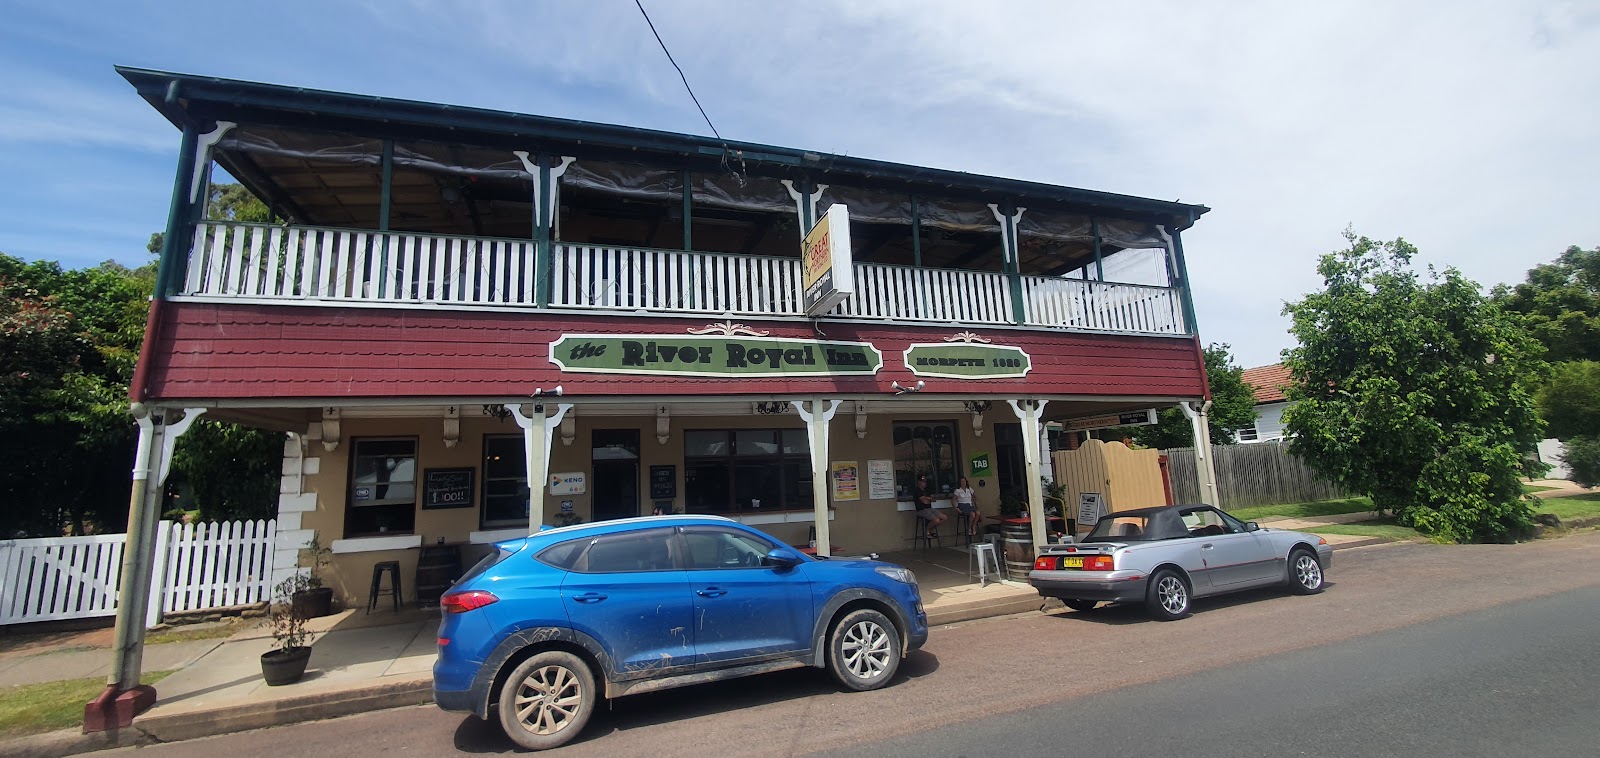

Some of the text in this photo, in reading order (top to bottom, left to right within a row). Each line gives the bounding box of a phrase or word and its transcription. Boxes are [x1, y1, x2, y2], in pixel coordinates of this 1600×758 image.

[811, 231, 829, 260] GREAT
[818, 273, 830, 289] ROYAL
[569, 340, 869, 369] the River Royal Inn
[916, 357, 986, 367] MORPETH
[972, 460, 988, 469] TAB
